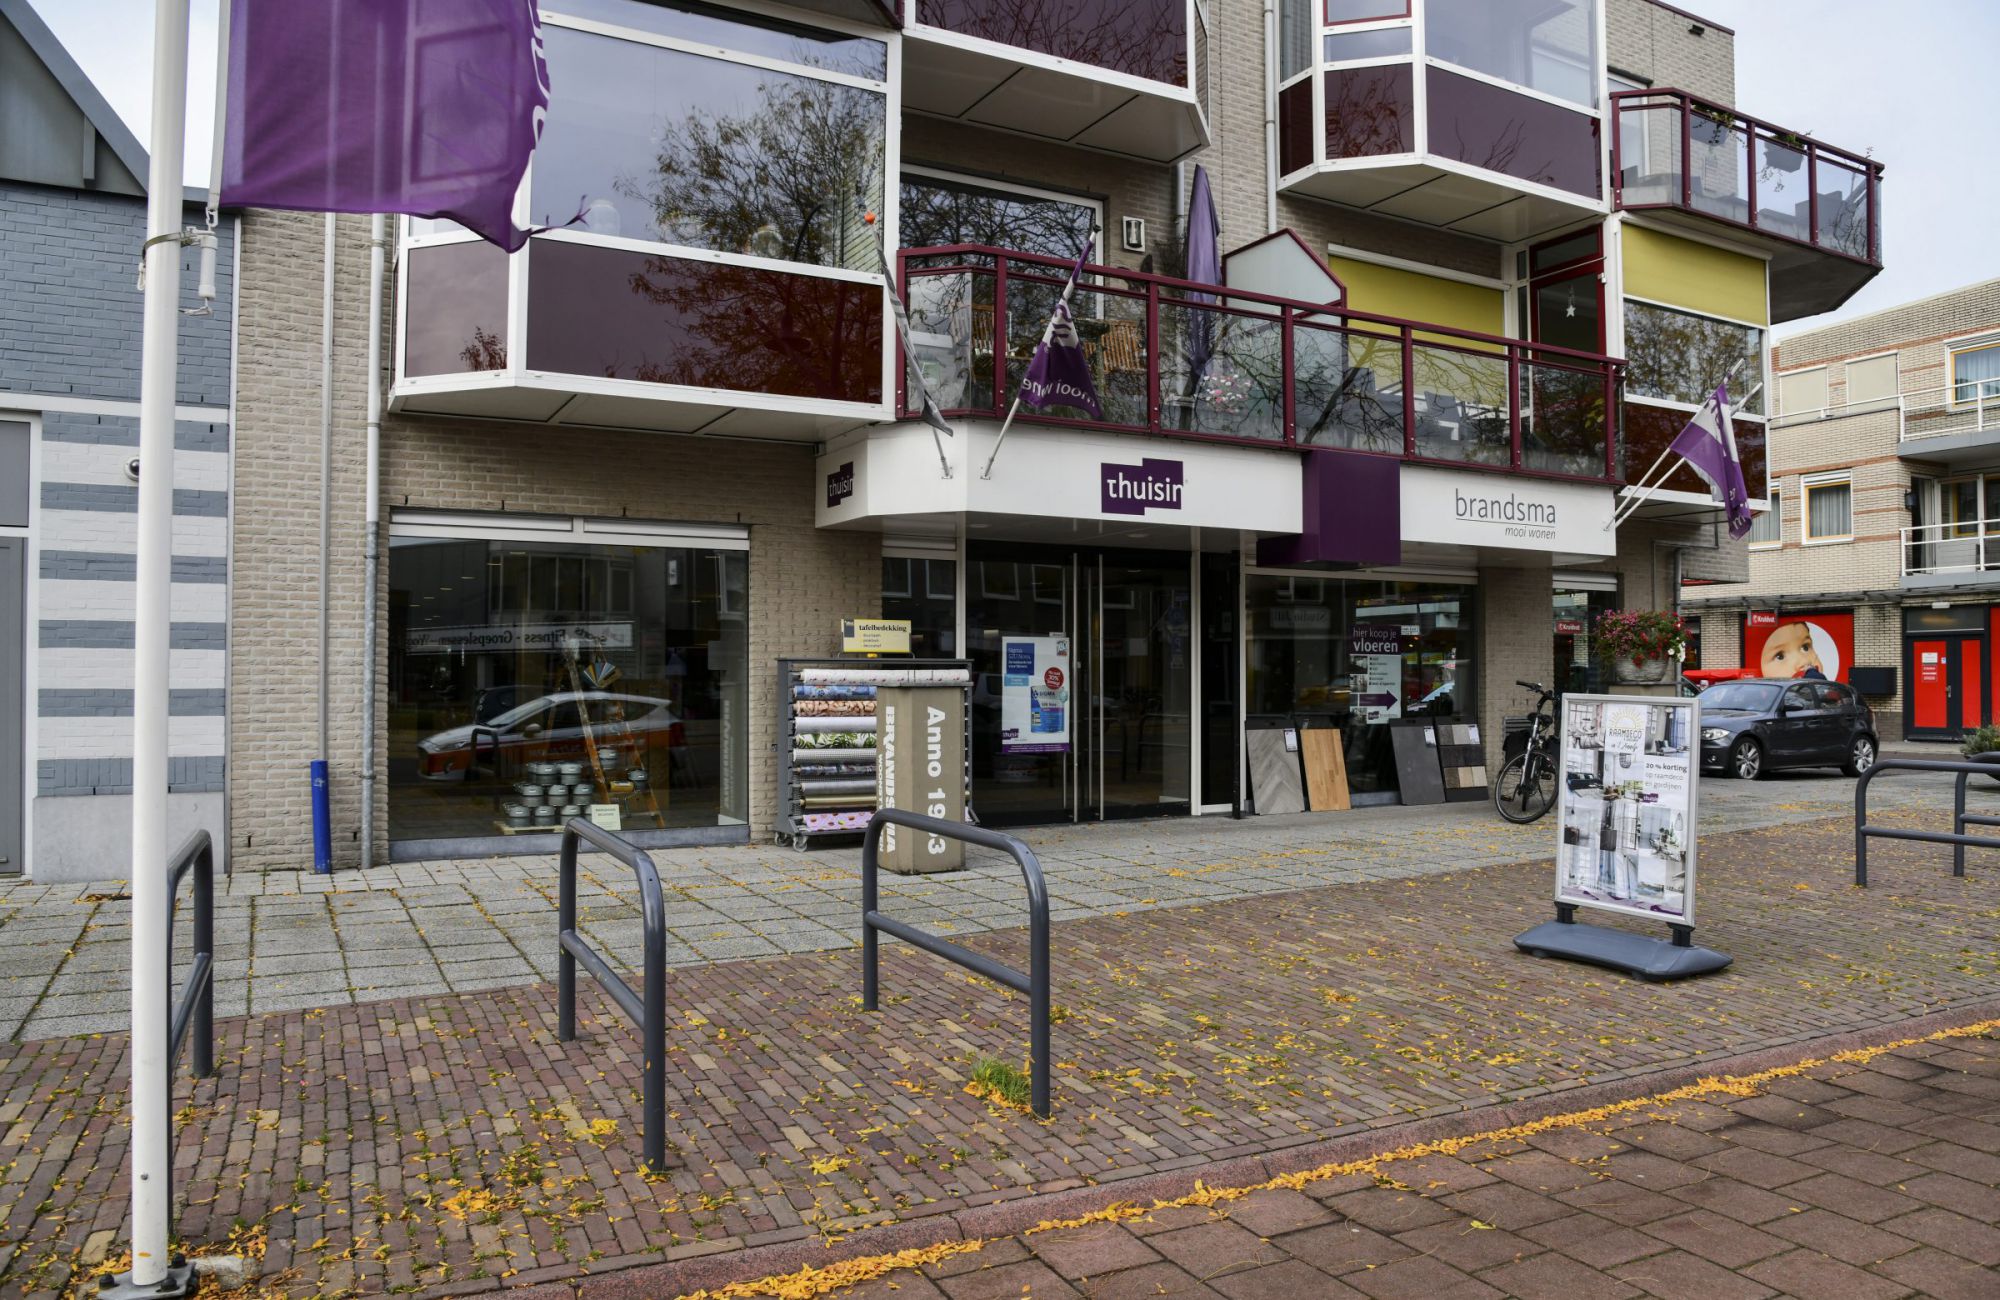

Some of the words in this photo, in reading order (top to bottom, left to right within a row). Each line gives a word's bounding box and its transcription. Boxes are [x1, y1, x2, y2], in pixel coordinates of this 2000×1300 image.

[1107, 472, 1183, 502] thuisin
[1456, 488, 1556, 524] brandsma
[1504, 526, 1526, 538] mooi
[1529, 530, 1556, 540] wonen
[1353, 627, 1368, 638] hier
[1370, 627, 1388, 640] koop
[1390, 630, 1397, 640] je
[1353, 638, 1398, 652] vloeren
[928, 706, 946, 778] Anno
[1662, 762, 1688, 773] korting
[1654, 780, 1682, 790] gordijnen
[928, 788, 946, 854] 193
